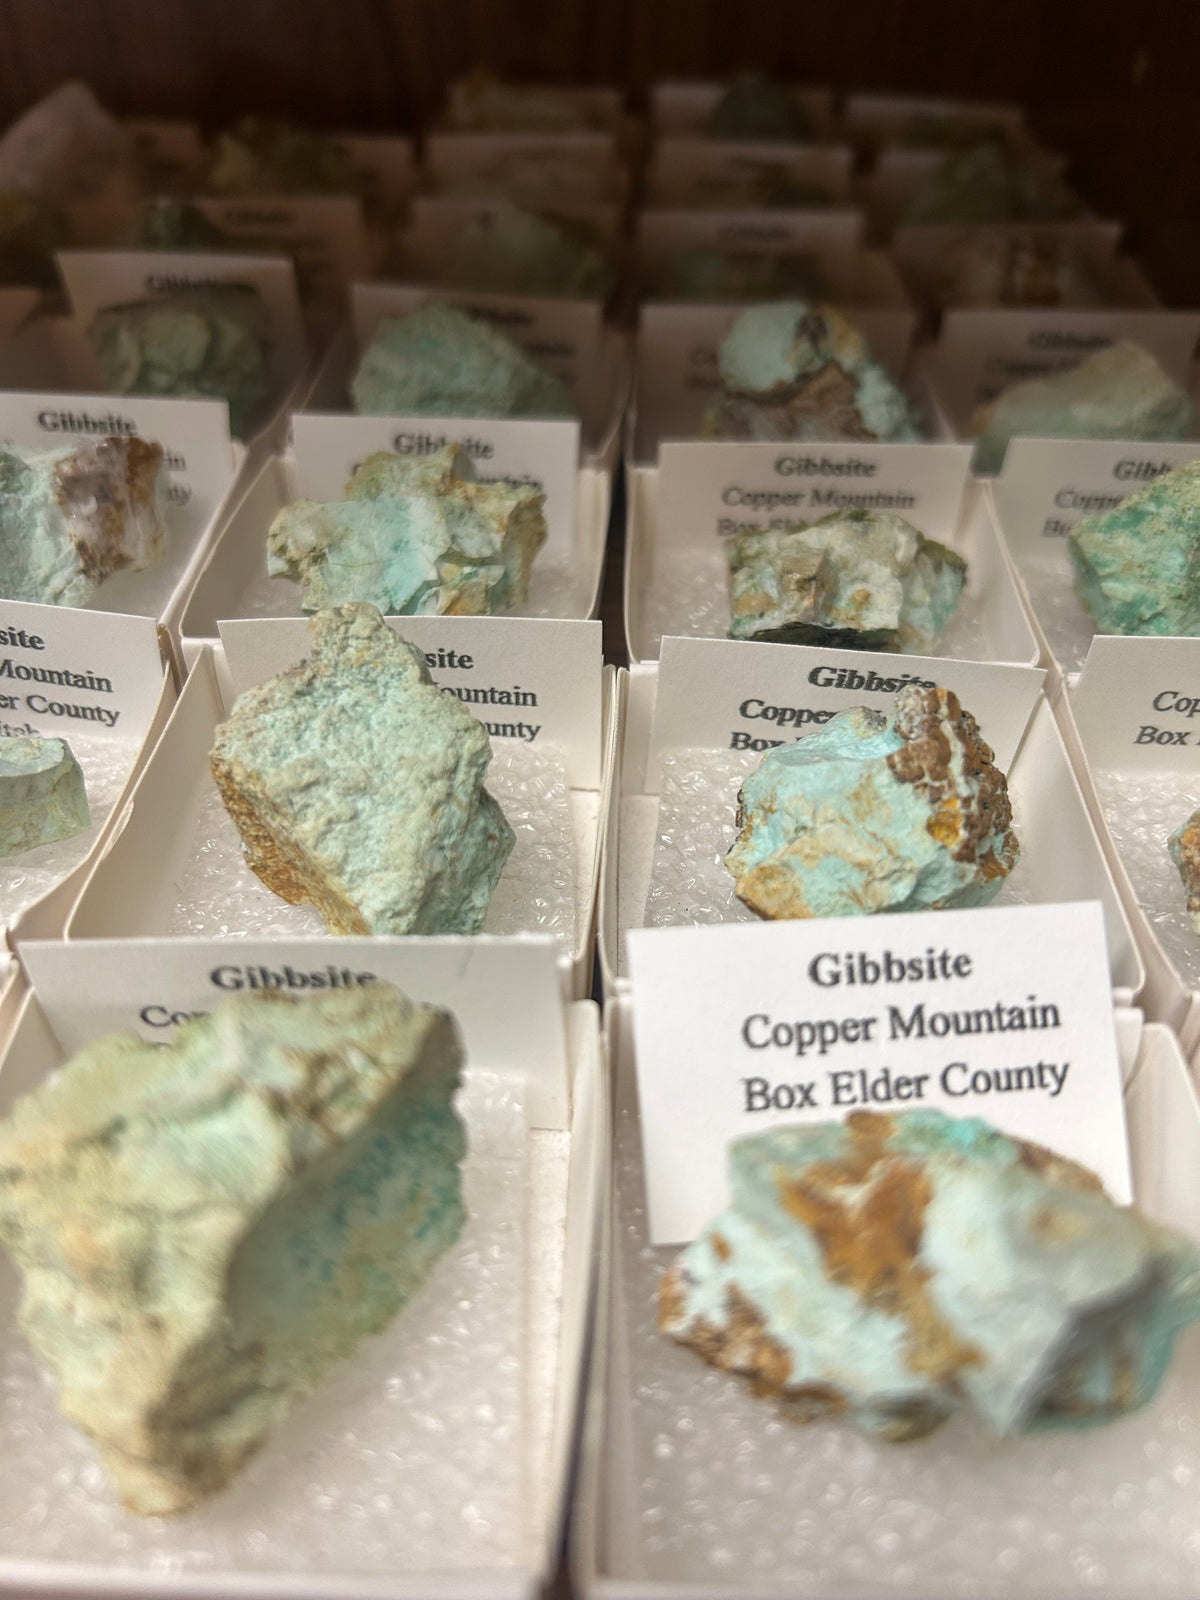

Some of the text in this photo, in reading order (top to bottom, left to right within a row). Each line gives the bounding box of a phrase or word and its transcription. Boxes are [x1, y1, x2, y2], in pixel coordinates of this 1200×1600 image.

[394, 433, 494, 459] Gibite
[774, 456, 877, 477] Gibbsite
[1113, 460, 1173, 481] Gibb
[722, 487, 916, 511] Copper Mountain
[0, 626, 45, 651] site
[425, 648, 475, 670] site
[440, 685, 539, 707] ountain
[1152, 690, 1200, 718] Cop
[26, 694, 121, 728] County
[485, 721, 542, 743] unty
[730, 731, 786, 751] Box
[1132, 725, 1191, 746] Box
[808, 948, 973, 987] Gibbsite
[741, 995, 1061, 1056] Copper Mountain
[741, 1060, 1070, 1112] Box Elder County
